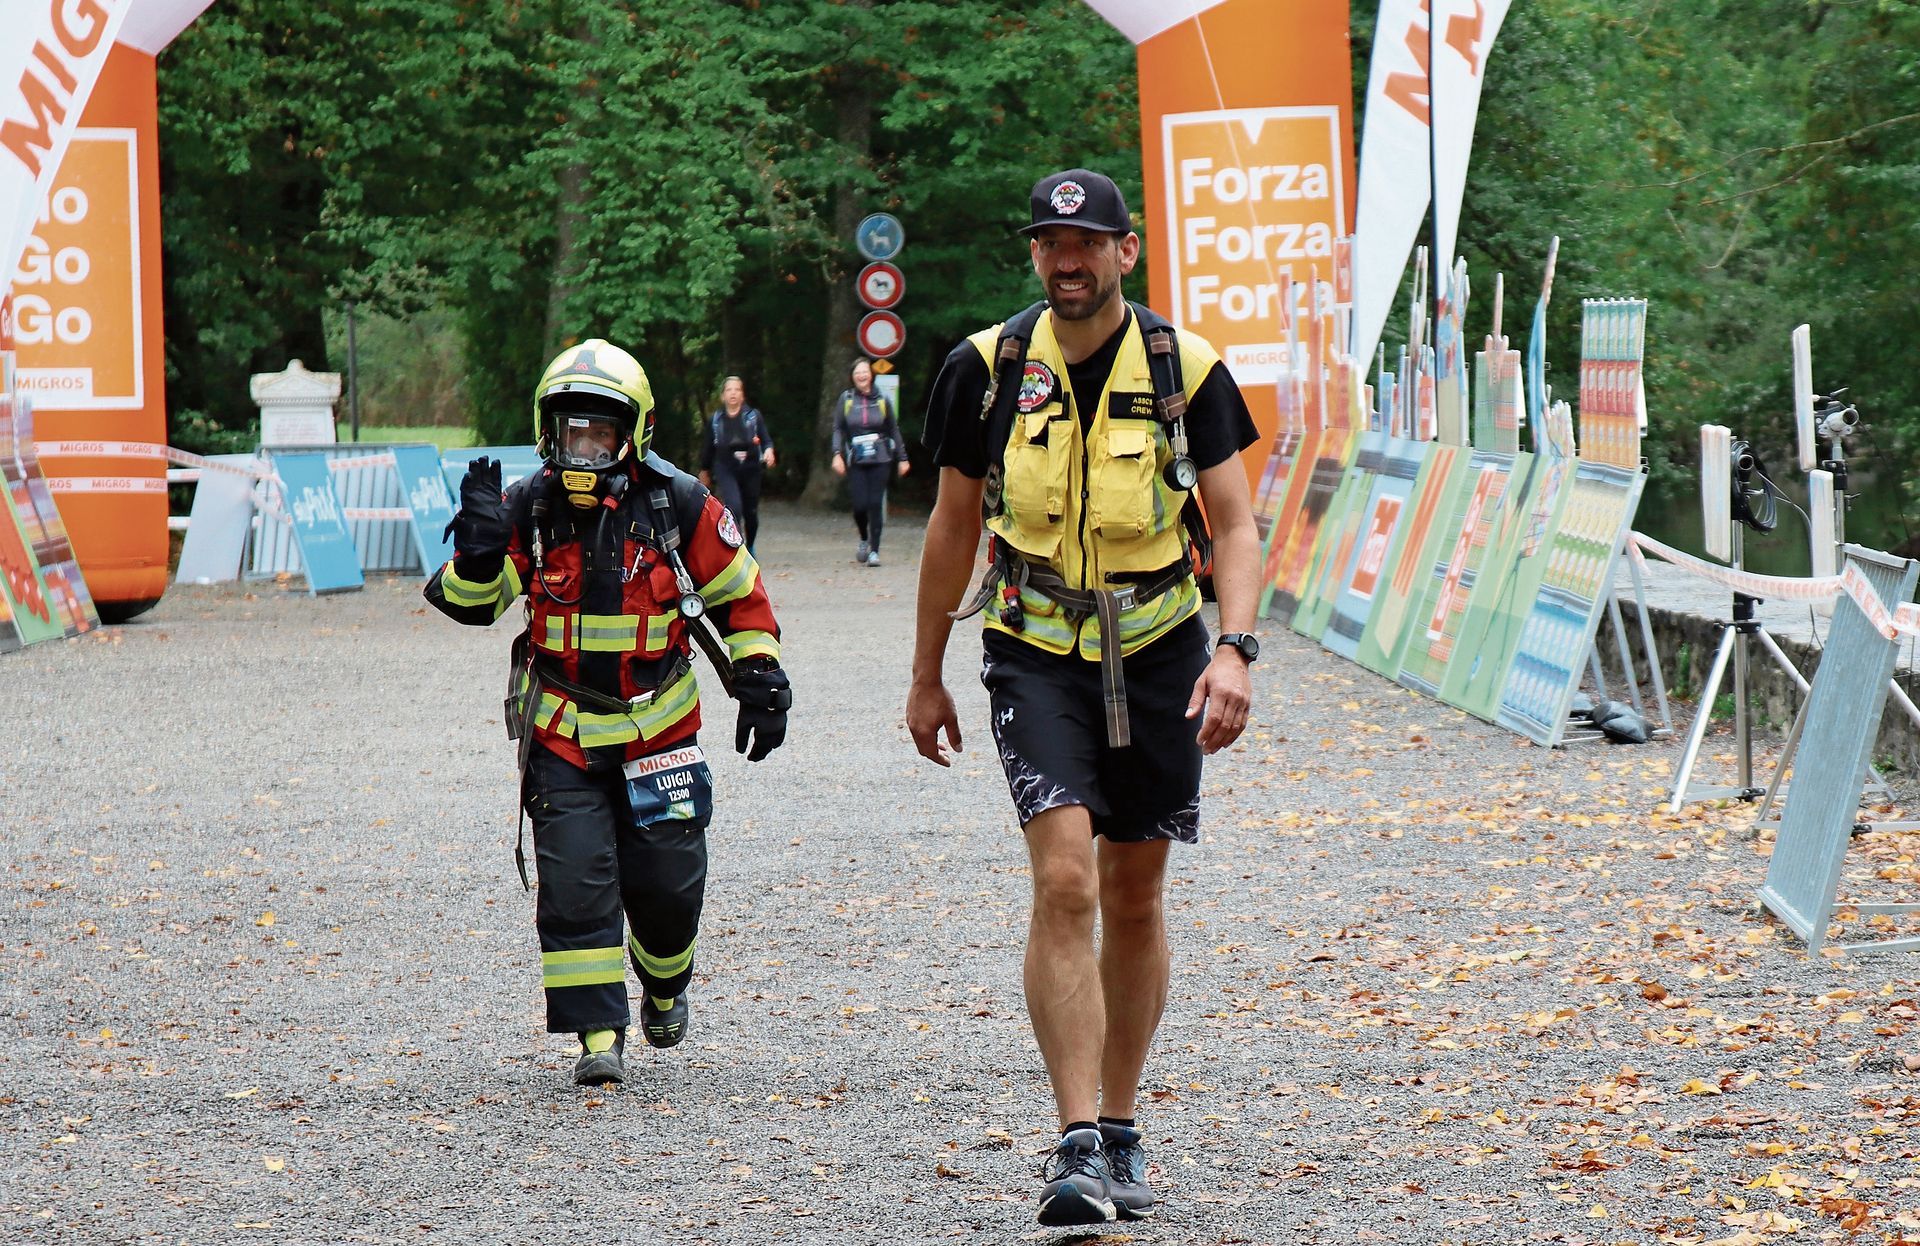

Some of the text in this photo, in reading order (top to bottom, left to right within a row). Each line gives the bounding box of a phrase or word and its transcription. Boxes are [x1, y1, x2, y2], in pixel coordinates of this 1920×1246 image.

[0, 0, 110, 184] MIG
[1181, 157, 1328, 205] Forza
[1185, 216, 1332, 265] Forza
[13, 234, 90, 285] Go
[13, 294, 91, 345] Go
[1236, 351, 1290, 366] MIGRO
[16, 376, 85, 390] MIGROS
[1131, 405, 1153, 415] CREW
[60, 443, 153, 455] MIGROS MIGROS
[50, 480, 72, 489] ROS
[92, 479, 132, 489] MIGROS
[639, 750, 696, 774] MIGROS
[655, 771, 693, 791] LUIGIA
[668, 787, 690, 802] 12500
